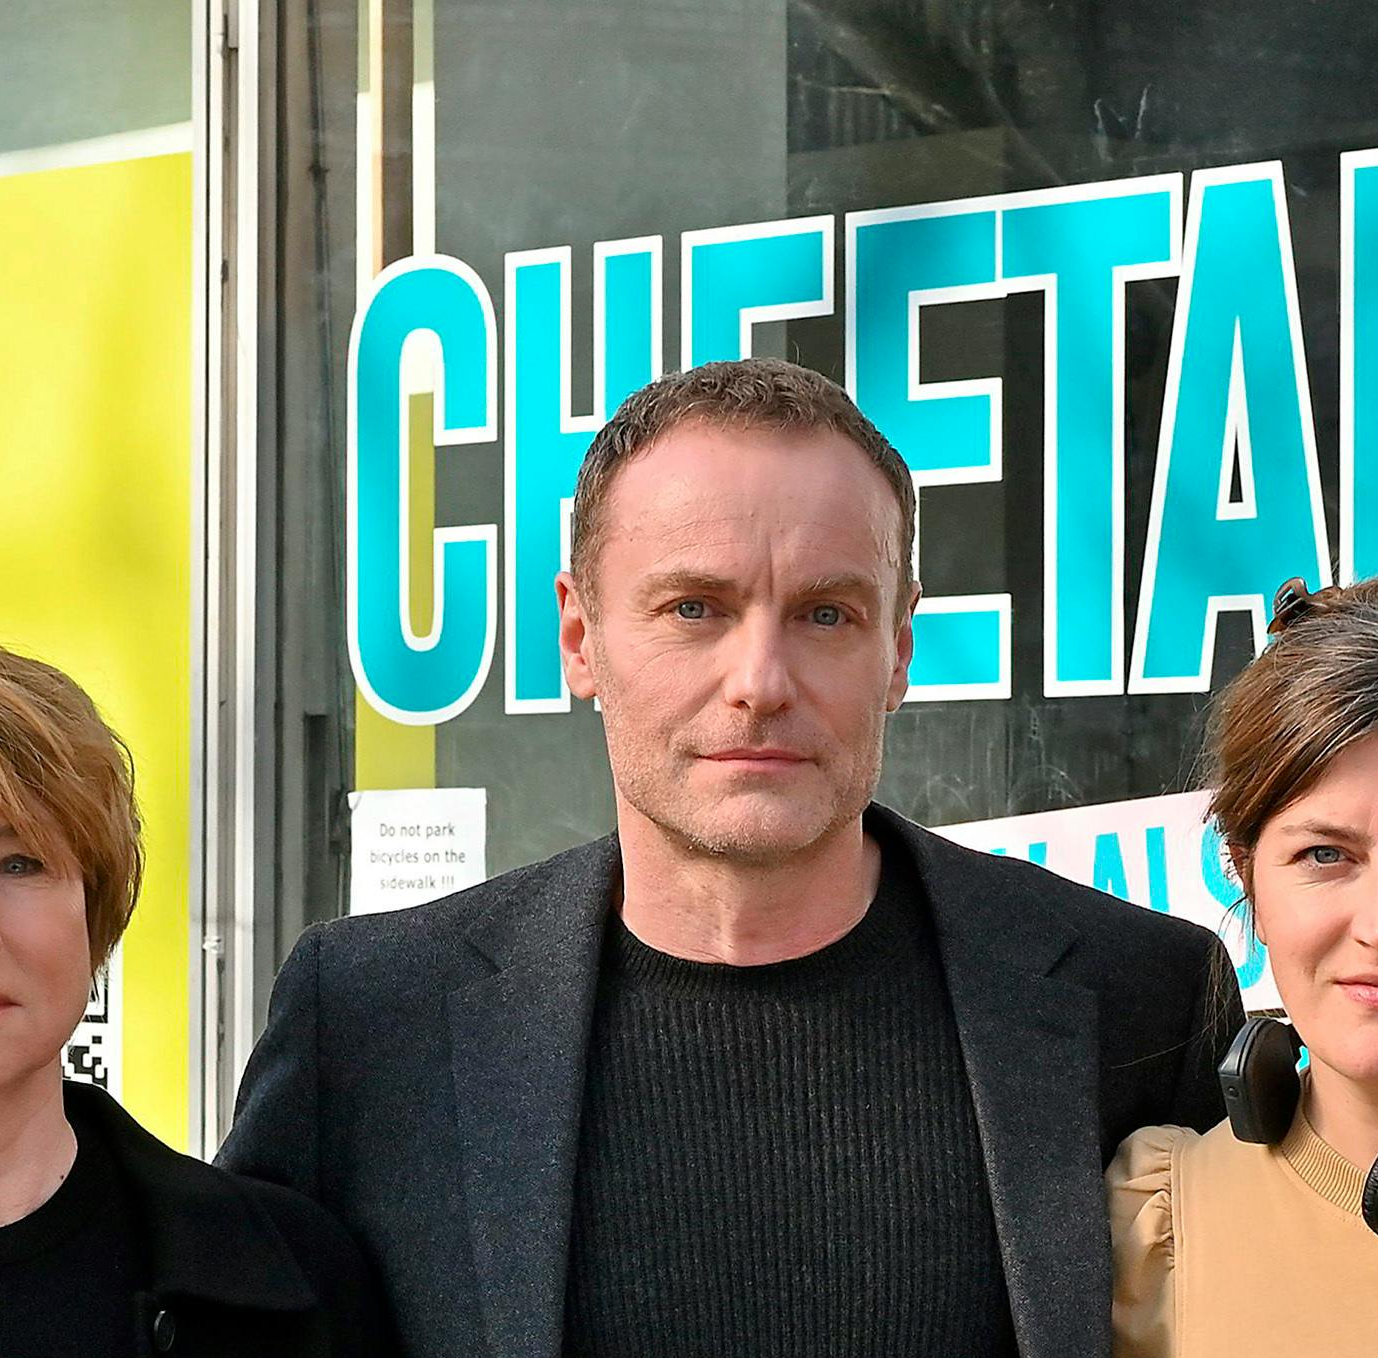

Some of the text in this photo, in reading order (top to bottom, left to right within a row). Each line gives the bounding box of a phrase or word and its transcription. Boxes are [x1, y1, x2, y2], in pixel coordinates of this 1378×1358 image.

[379, 822, 455, 839] Do not park
[370, 850, 466, 865] bicycles on the
[380, 876, 455, 889] sidewalk !!!
